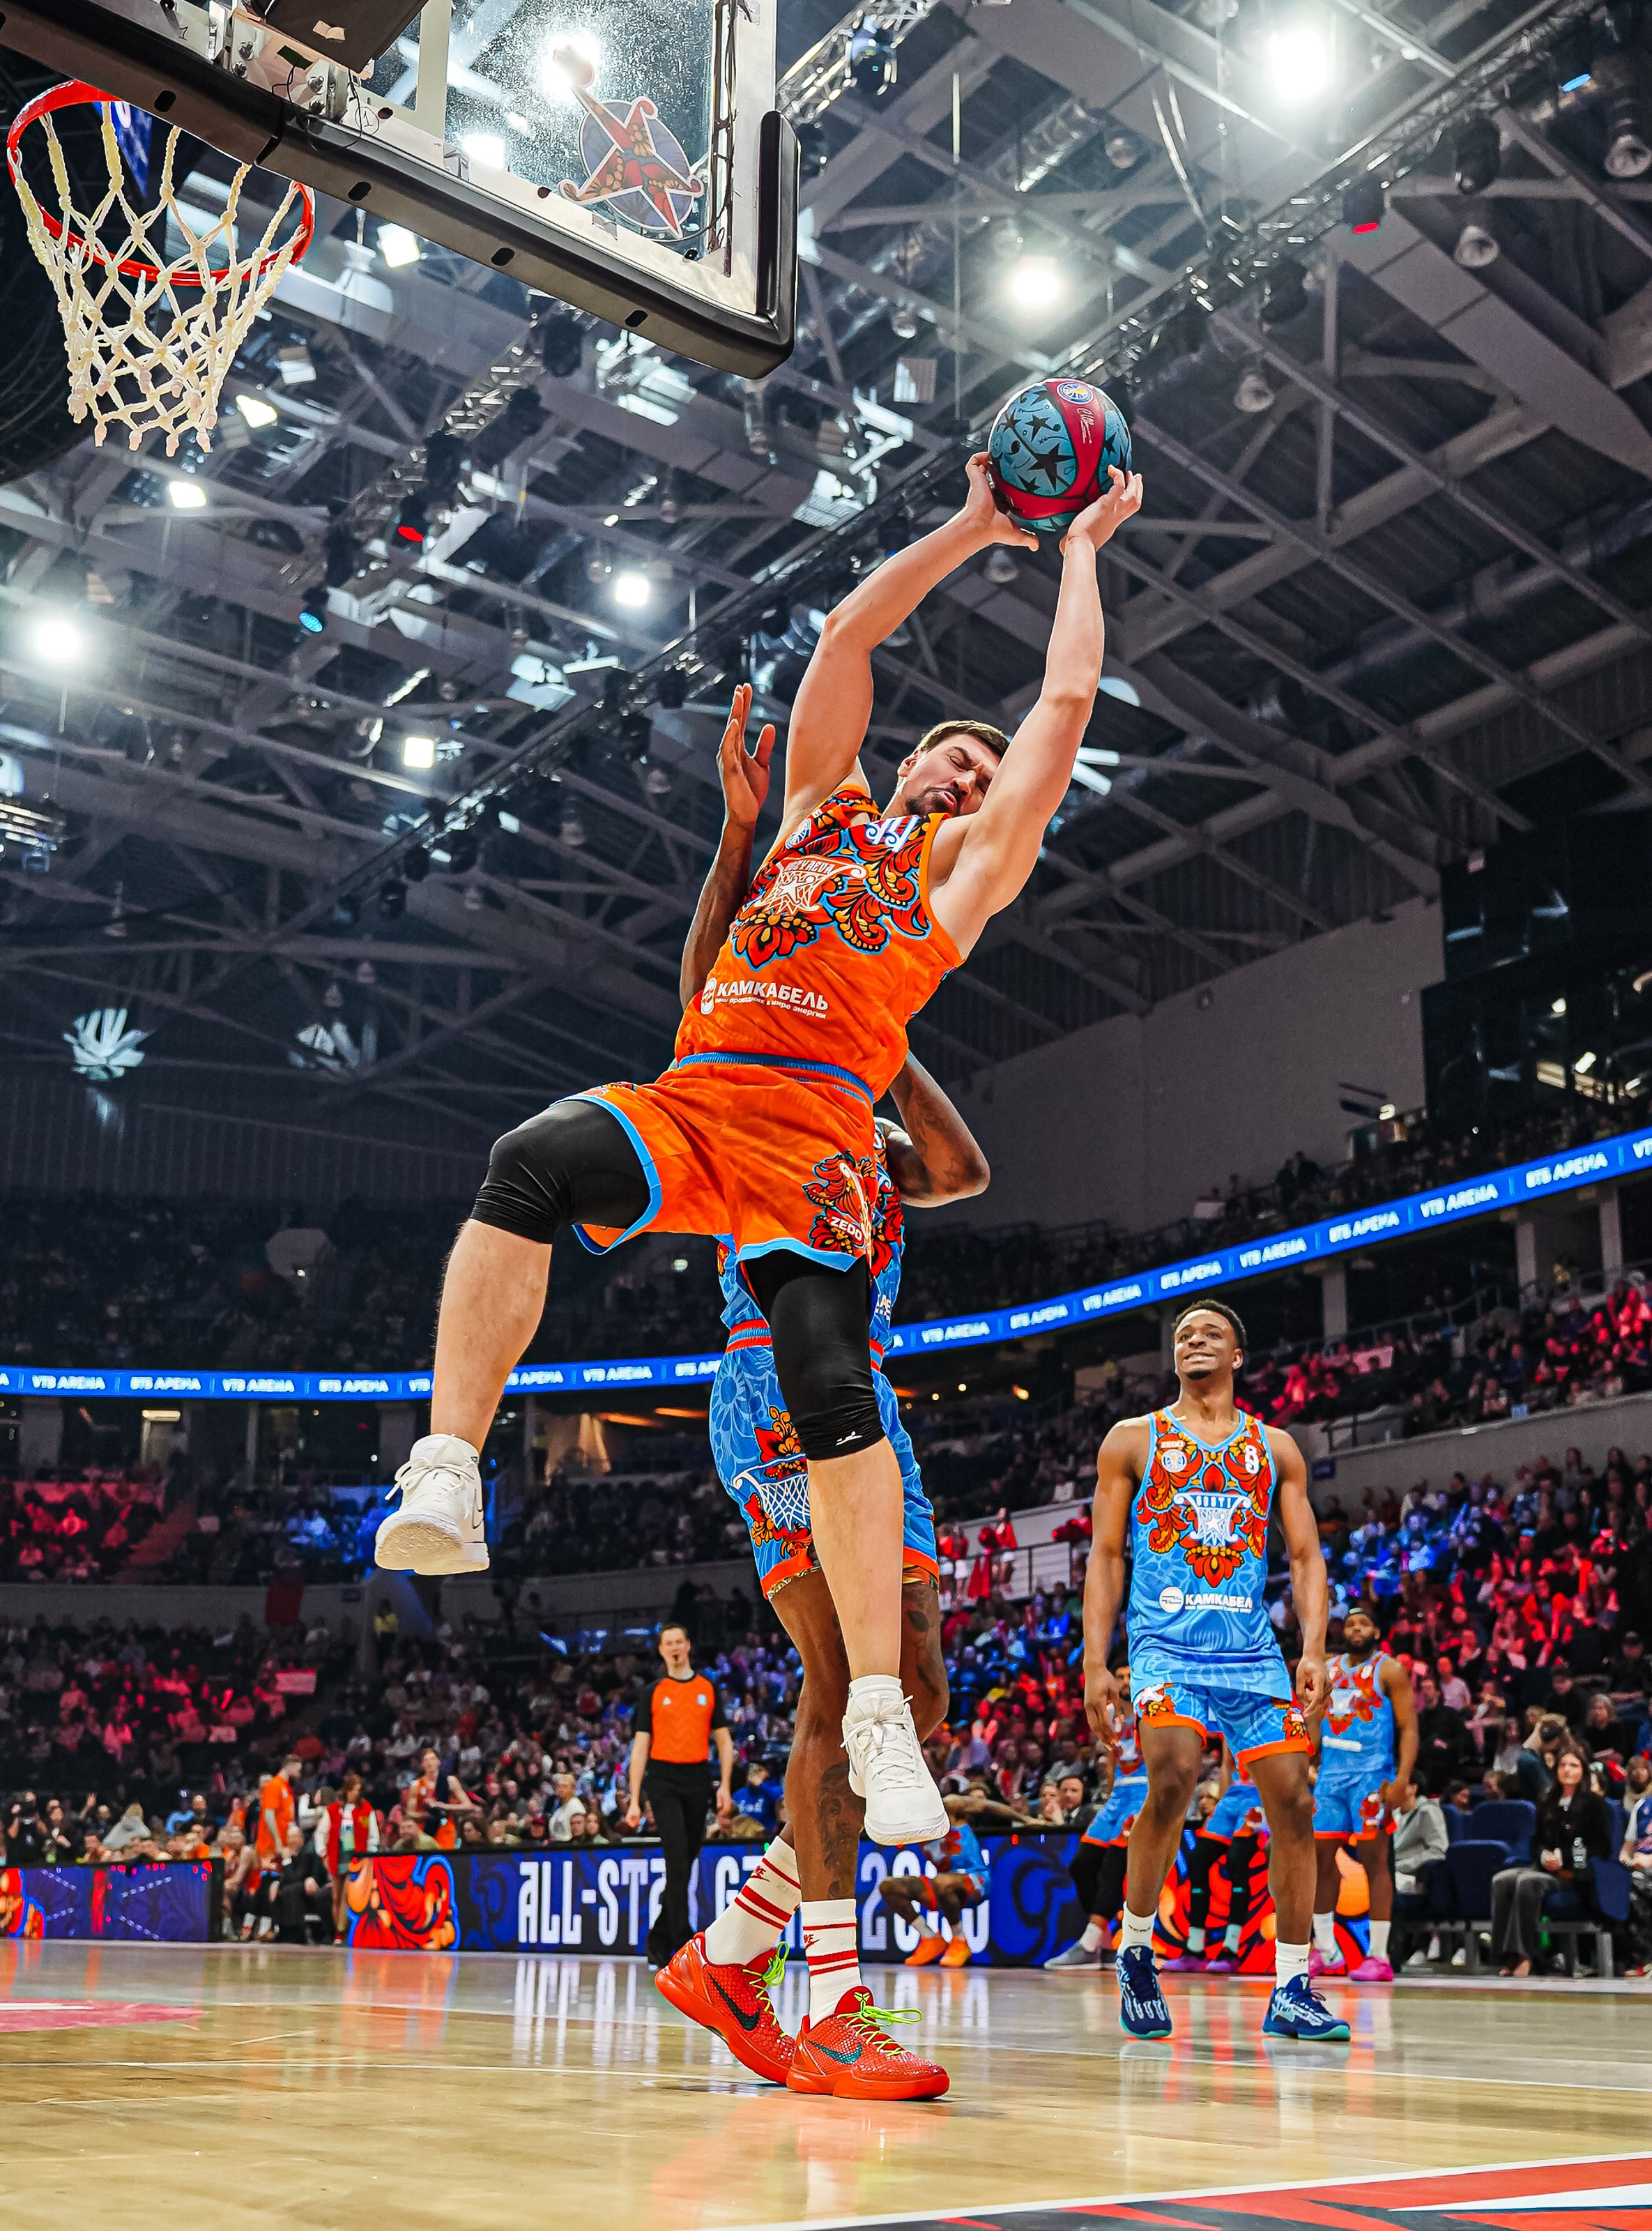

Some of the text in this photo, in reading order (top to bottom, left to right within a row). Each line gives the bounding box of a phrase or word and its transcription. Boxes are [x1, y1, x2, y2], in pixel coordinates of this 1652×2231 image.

[717, 980, 829, 1011] КАМКАБЕЛЬ
[830, 1216, 862, 1241] ZEDO
[1185, 1593, 1253, 1609] КАМКАБЕЛ
[518, 1857, 699, 1946] ALL-STA
